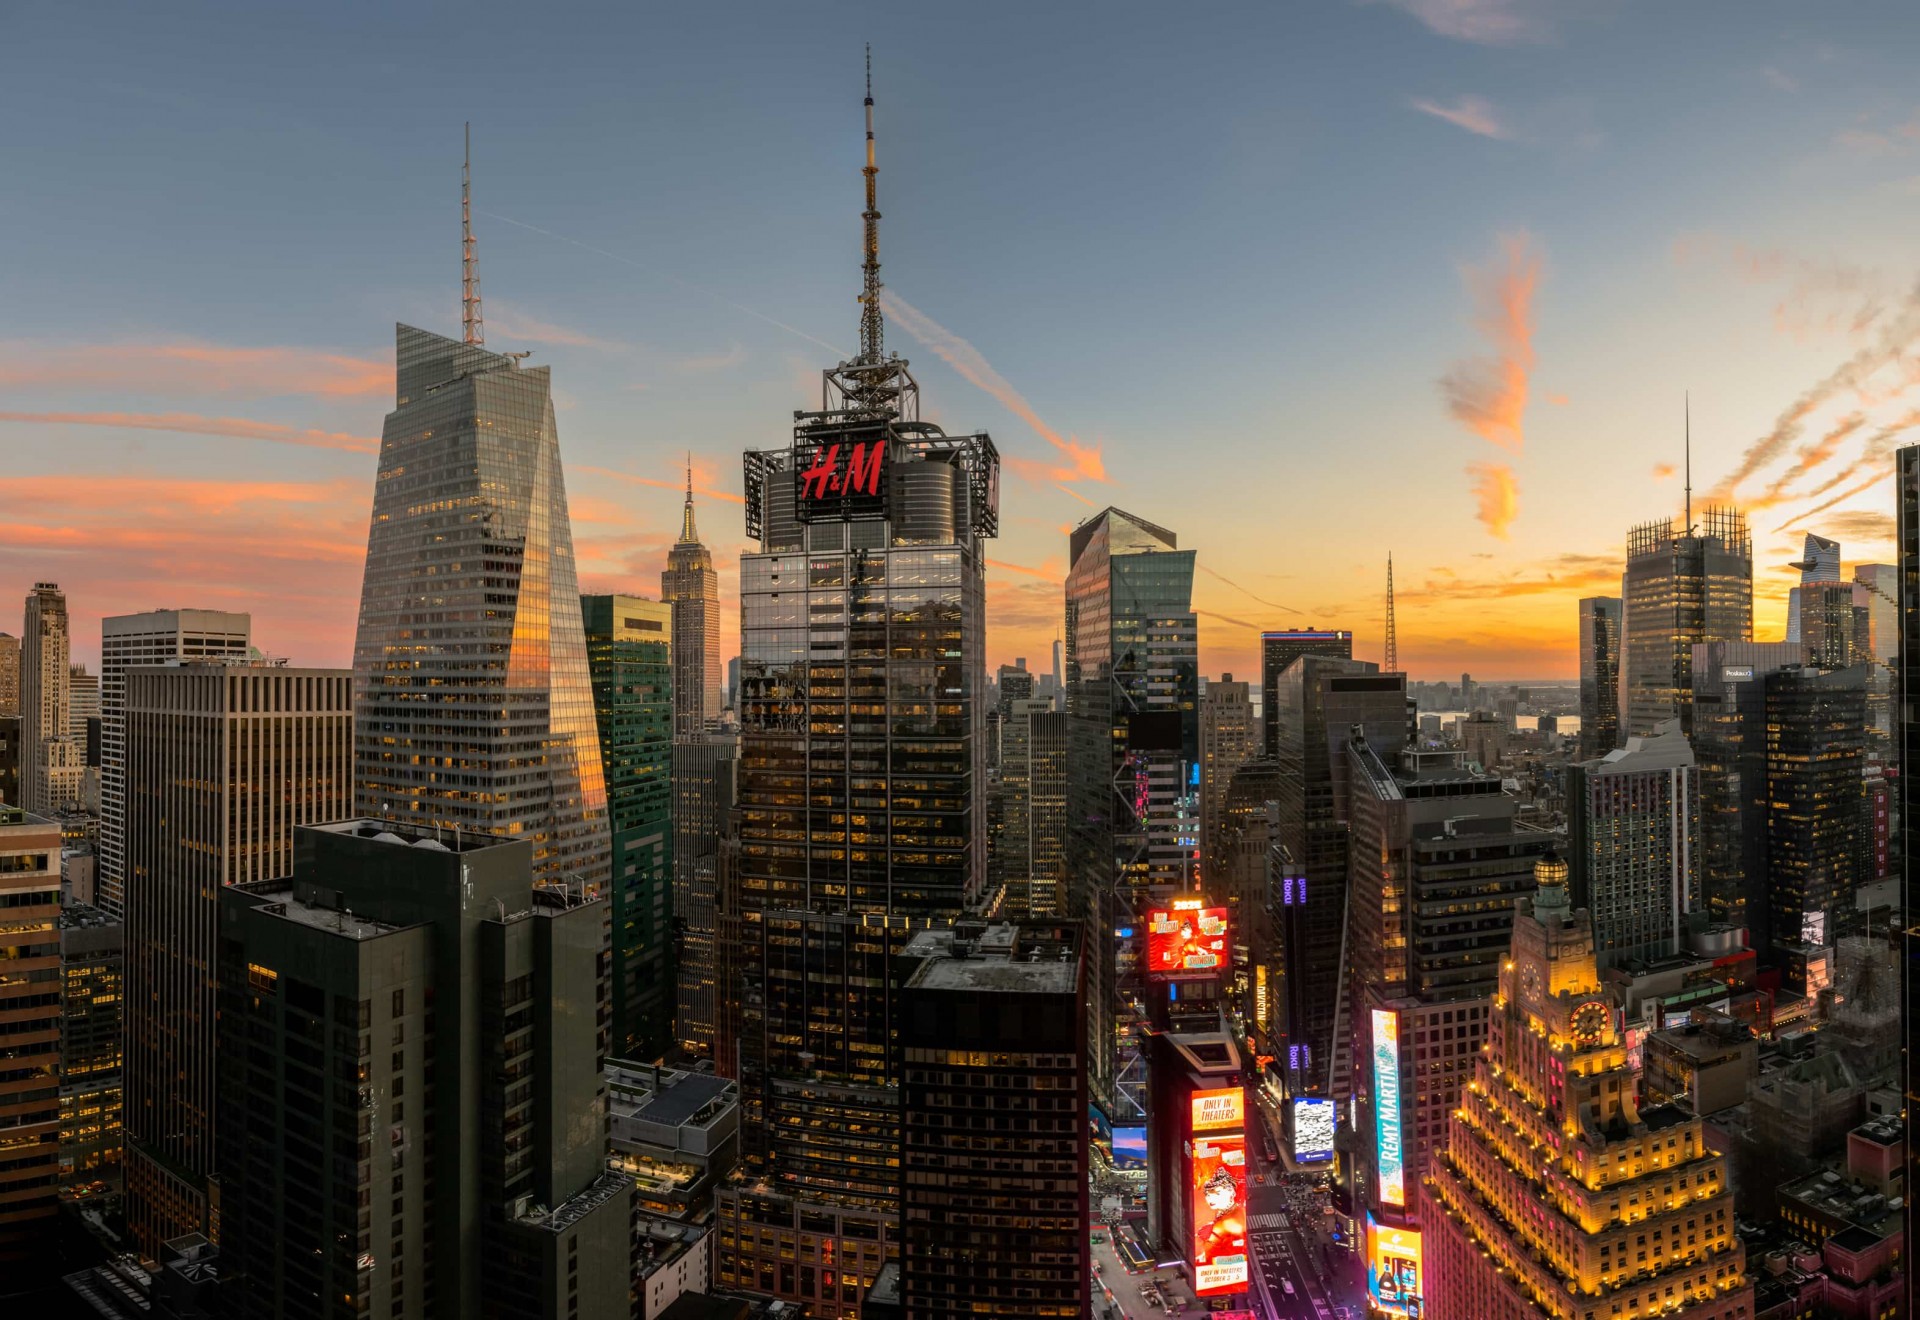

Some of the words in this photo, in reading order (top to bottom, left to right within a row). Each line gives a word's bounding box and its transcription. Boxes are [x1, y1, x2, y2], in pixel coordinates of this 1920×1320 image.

[801, 440, 886, 500] H&M
[1204, 1099, 1221, 1110] ONLY
[1224, 1098, 1231, 1108] IN
[1380, 1065, 1397, 1122] MARTIN
[1201, 1109, 1235, 1121] THEATERS
[1381, 1123, 1399, 1162] RÉMY
